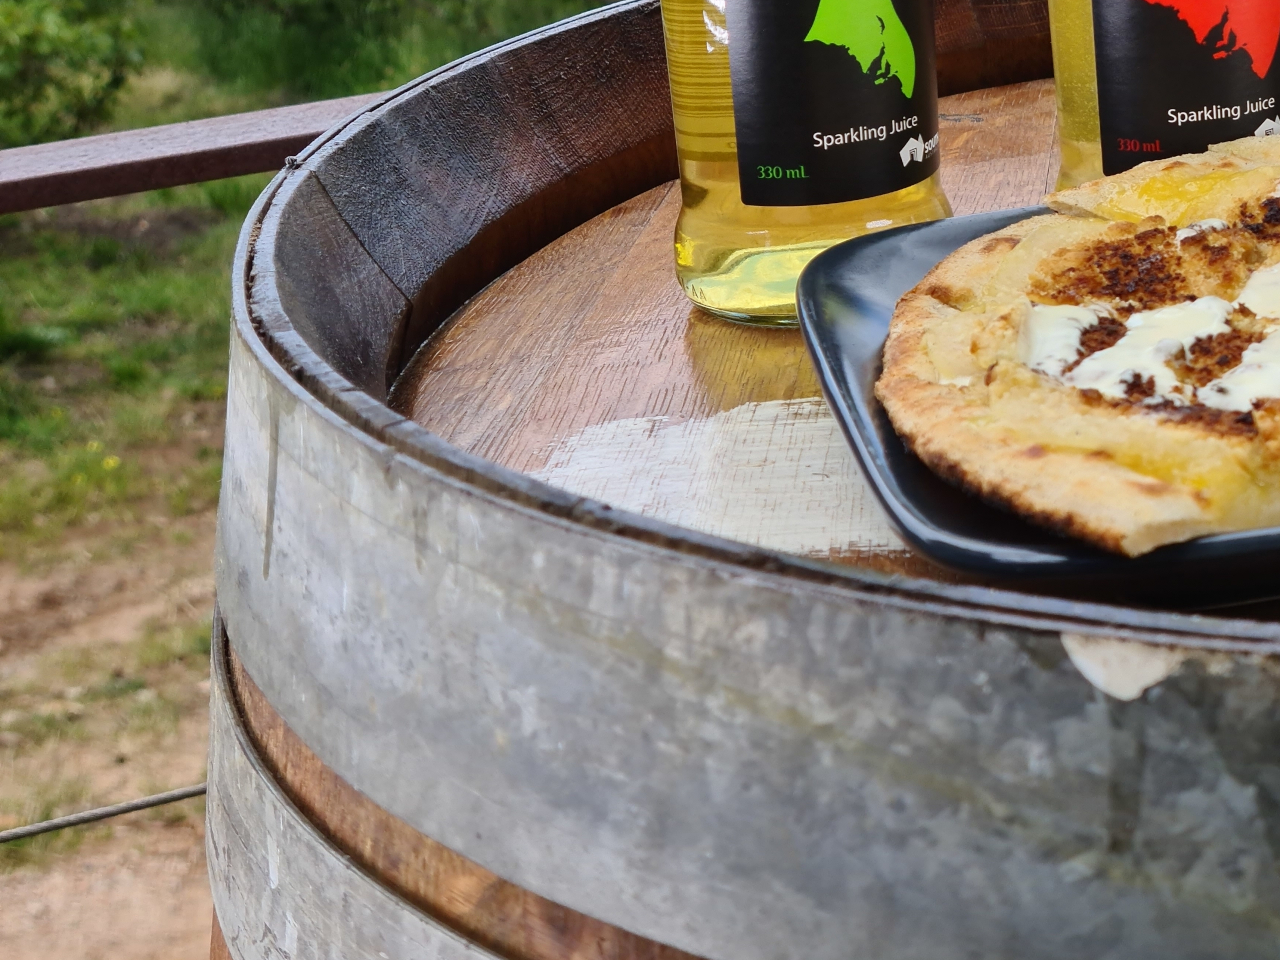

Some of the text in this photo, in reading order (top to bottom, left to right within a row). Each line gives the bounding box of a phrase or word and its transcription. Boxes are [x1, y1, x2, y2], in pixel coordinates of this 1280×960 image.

[1167, 97, 1276, 126] Sparkling Juice
[813, 115, 918, 150] Sparkling Juice
[1117, 138, 1140, 152] 330
[757, 165, 809, 179] 330 mL
